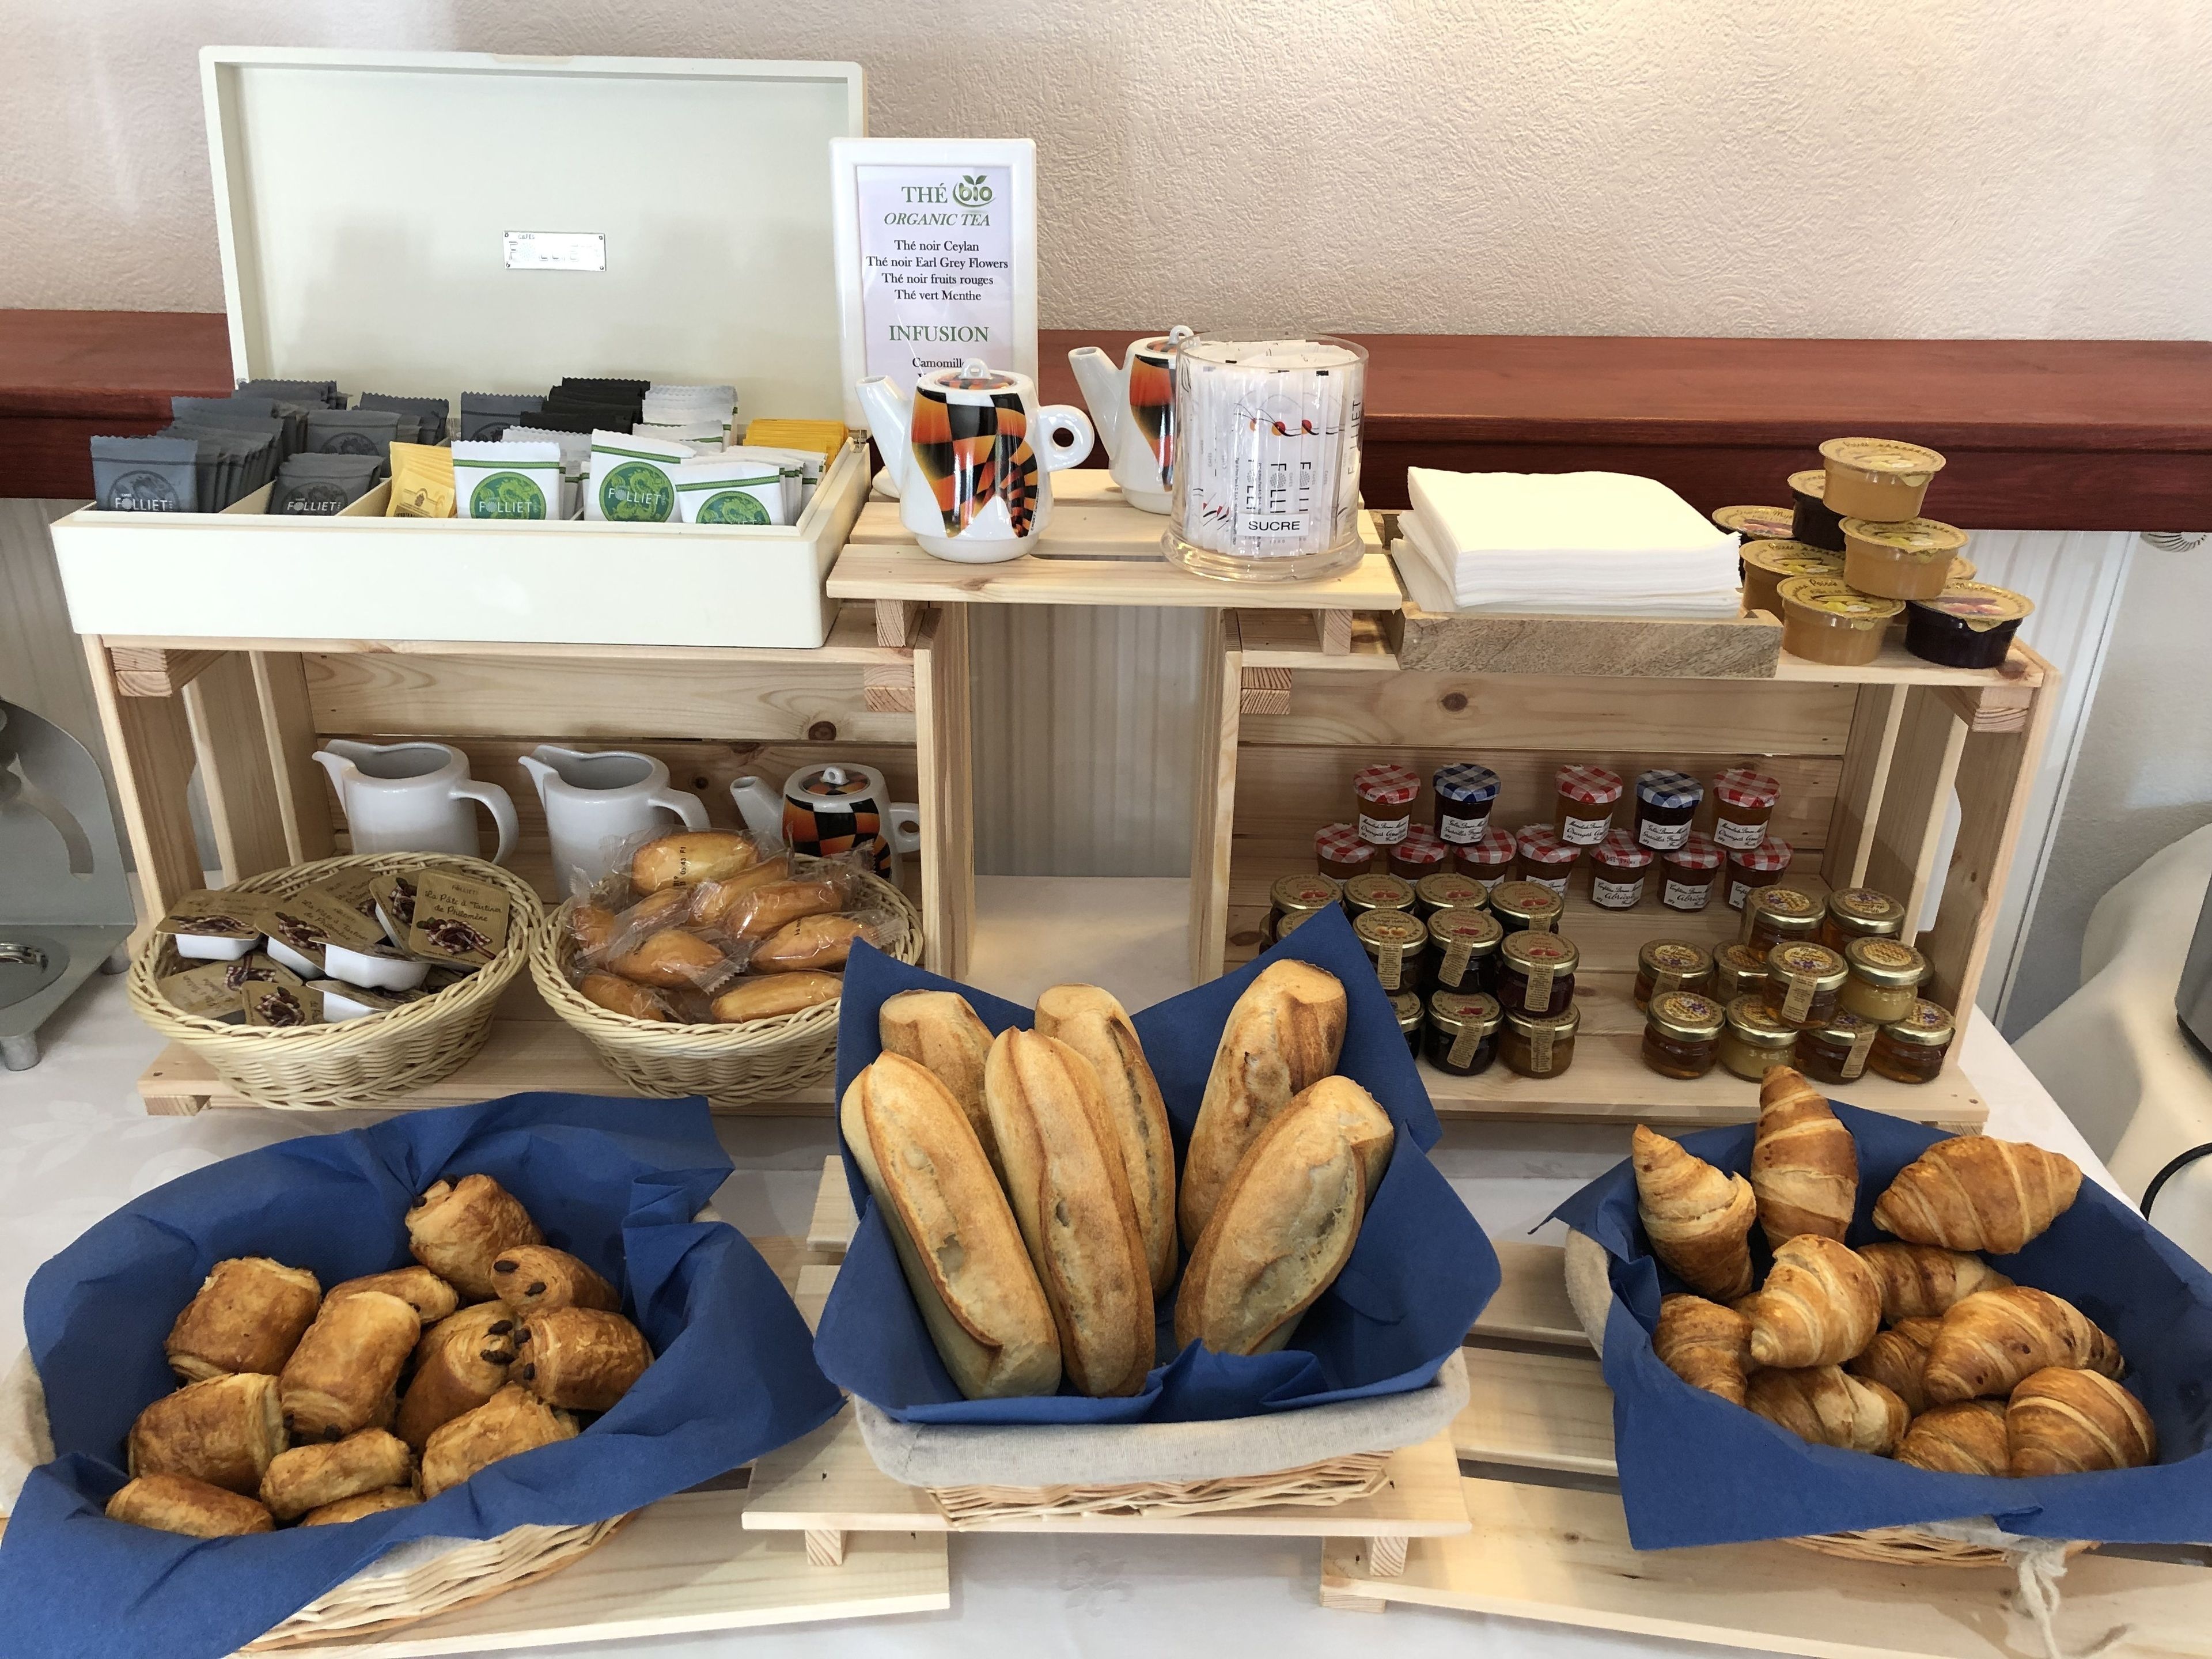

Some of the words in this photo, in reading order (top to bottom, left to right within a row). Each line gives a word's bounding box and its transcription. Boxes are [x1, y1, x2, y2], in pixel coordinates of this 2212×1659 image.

[902, 183, 948, 203] THÉ
[959, 183, 993, 201] bio
[884, 213, 957, 226] ORGANIC
[961, 214, 990, 226] TEA
[894, 240, 916, 251] Thé
[919, 241, 941, 251] noir
[944, 241, 979, 253] Ceylan
[866, 256, 888, 266] Thé
[891, 256, 912, 267] noir
[915, 257, 937, 267] Earl
[940, 257, 965, 270] Grey
[968, 258, 1008, 268] Flowers
[881, 273, 903, 283] Thé
[907, 274, 928, 283] noir
[930, 274, 957, 284] fruits
[960, 276, 994, 286] rouges
[894, 289, 916, 300] Thé
[919, 291, 940, 300] vert
[942, 290, 981, 301] Menthe
[889, 325, 989, 342] INFUSION
[912, 357, 964, 368] Camomill
[115, 497, 168, 511] FOLLIET
[287, 502, 336, 511] FOLLIET
[479, 501, 532, 513] FOLLIET
[1248, 521, 1300, 531] SUCRE
[425, 891, 437, 899] La
[440, 894, 459, 906] Pâte
[470, 902, 502, 913] Tartiner
[434, 904, 444, 912] de
[448, 906, 488, 922] Philomène
